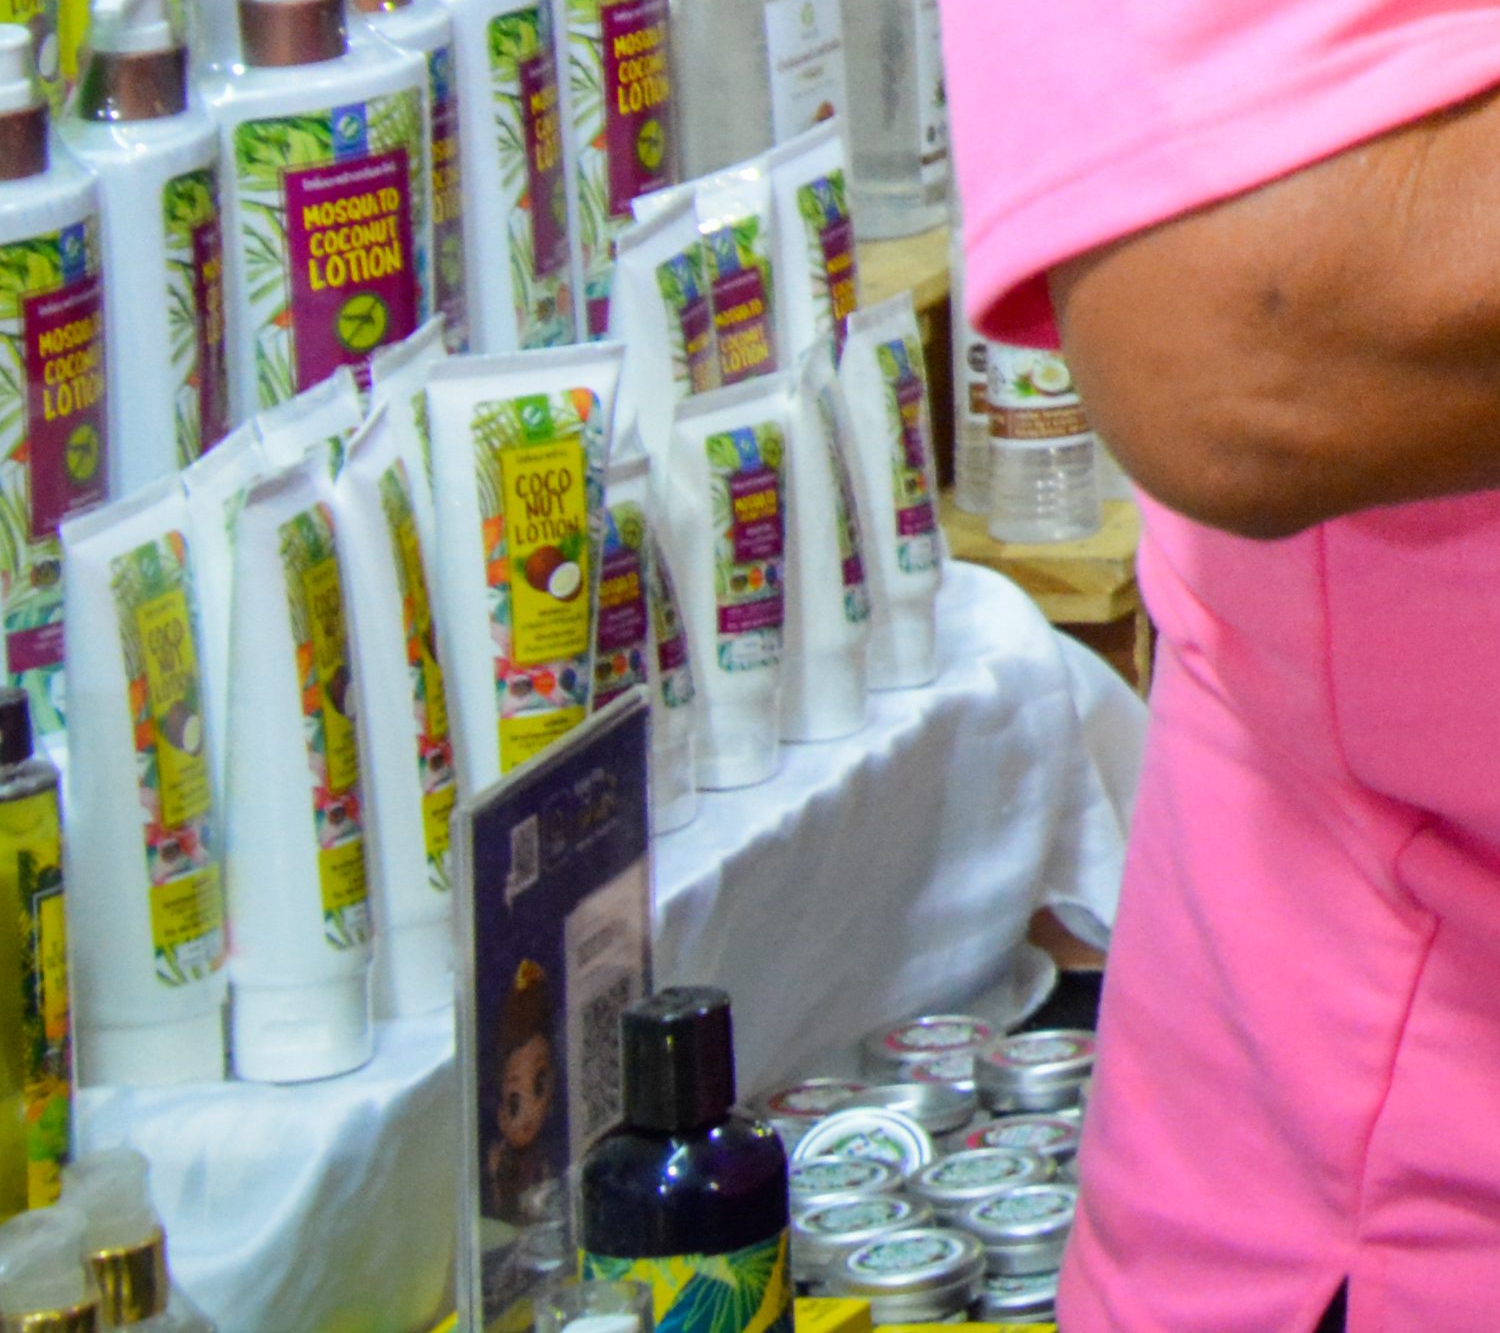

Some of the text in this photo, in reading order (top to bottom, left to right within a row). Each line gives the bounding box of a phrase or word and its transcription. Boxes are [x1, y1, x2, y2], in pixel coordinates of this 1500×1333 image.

[302, 186, 399, 231] MOSQUITO
[309, 215, 399, 257] COCONUT
[308, 239, 403, 292] LOTION
[515, 466, 573, 500] COCO
[524, 493, 565, 520] NUT
[514, 515, 580, 546] LOTION
